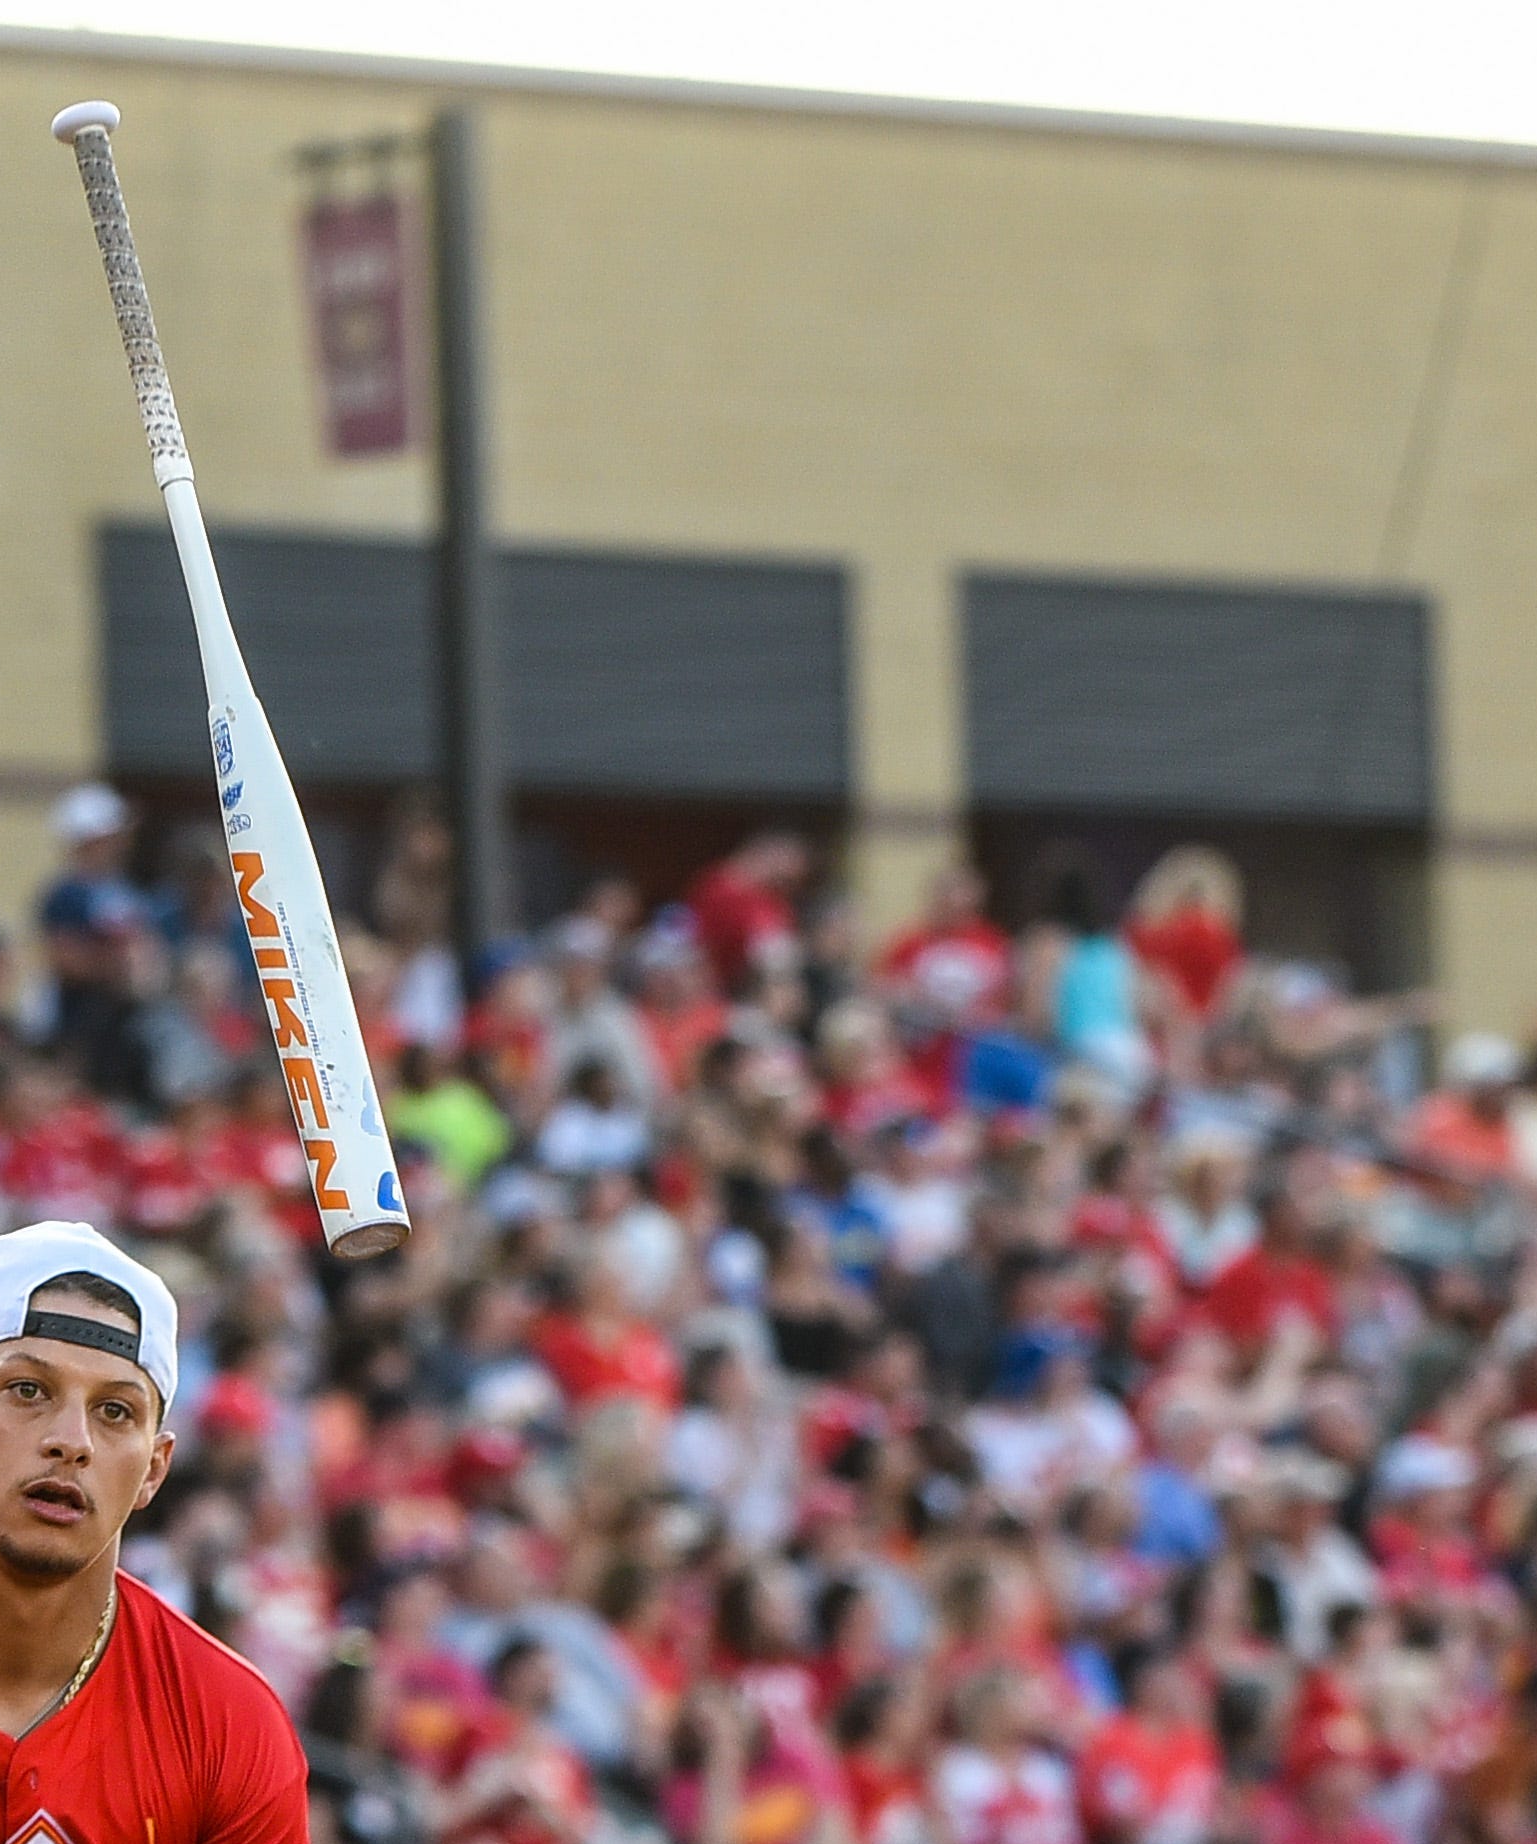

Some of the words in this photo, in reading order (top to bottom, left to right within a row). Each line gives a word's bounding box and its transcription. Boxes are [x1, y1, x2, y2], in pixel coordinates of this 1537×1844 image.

[230, 851, 351, 1212] MIKEN
[283, 925, 300, 969] COMPOSITE
[296, 981, 310, 1016] OFFICIAL
[307, 1019, 321, 1056] SOFTBALL
